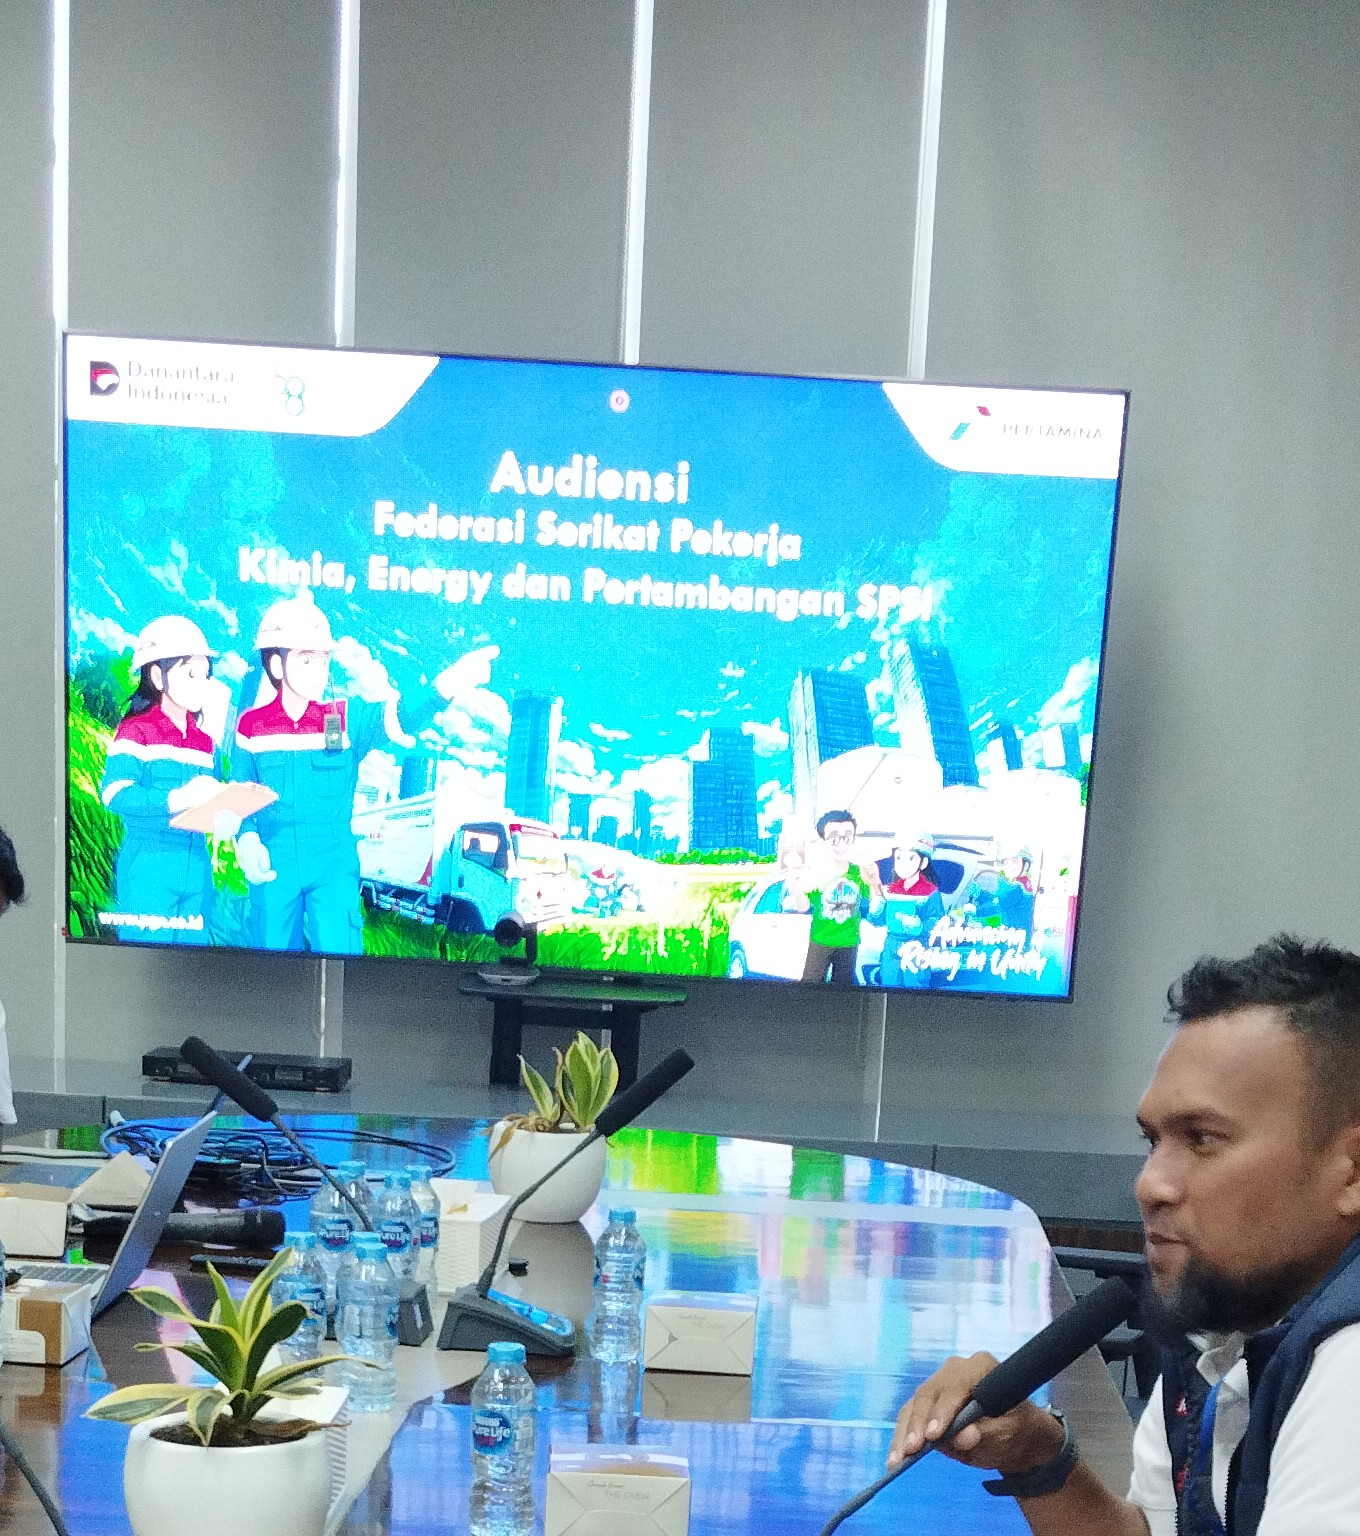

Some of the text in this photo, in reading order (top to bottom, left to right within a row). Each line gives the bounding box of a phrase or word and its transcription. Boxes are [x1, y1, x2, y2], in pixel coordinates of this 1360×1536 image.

[489, 450, 690, 504] Audiensi
[373, 499, 802, 568] Federasi Serikat Pekerja
[238, 546, 933, 623] Kimia, Energy dan Pertambangan SPSI
